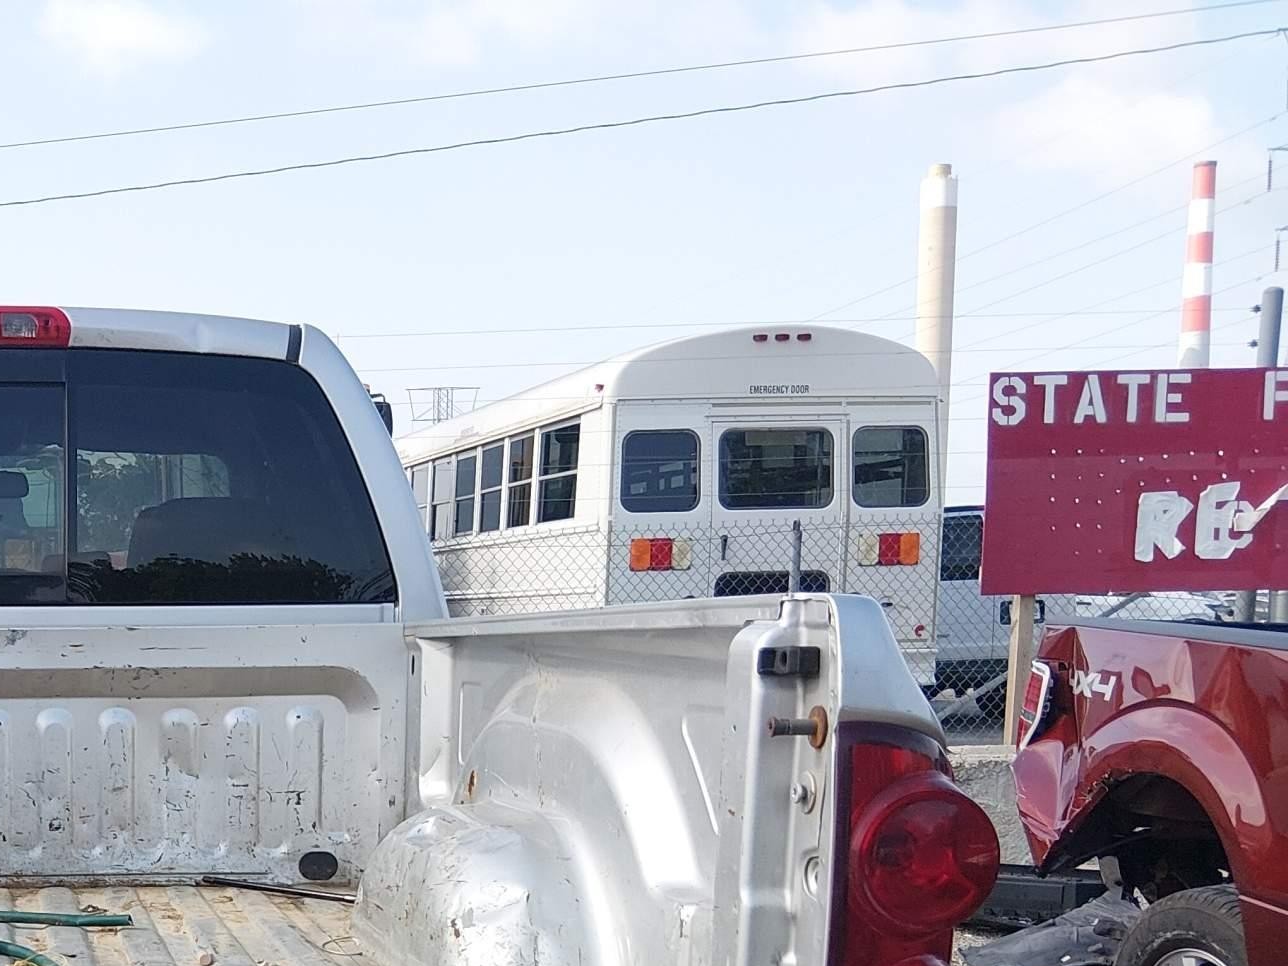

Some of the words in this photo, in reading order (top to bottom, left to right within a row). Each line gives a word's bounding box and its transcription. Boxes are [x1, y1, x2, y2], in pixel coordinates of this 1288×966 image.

[749, 385, 790, 395] EMERGENCY
[790, 384, 810, 394] DOOR
[991, 374, 1192, 426] STATE
